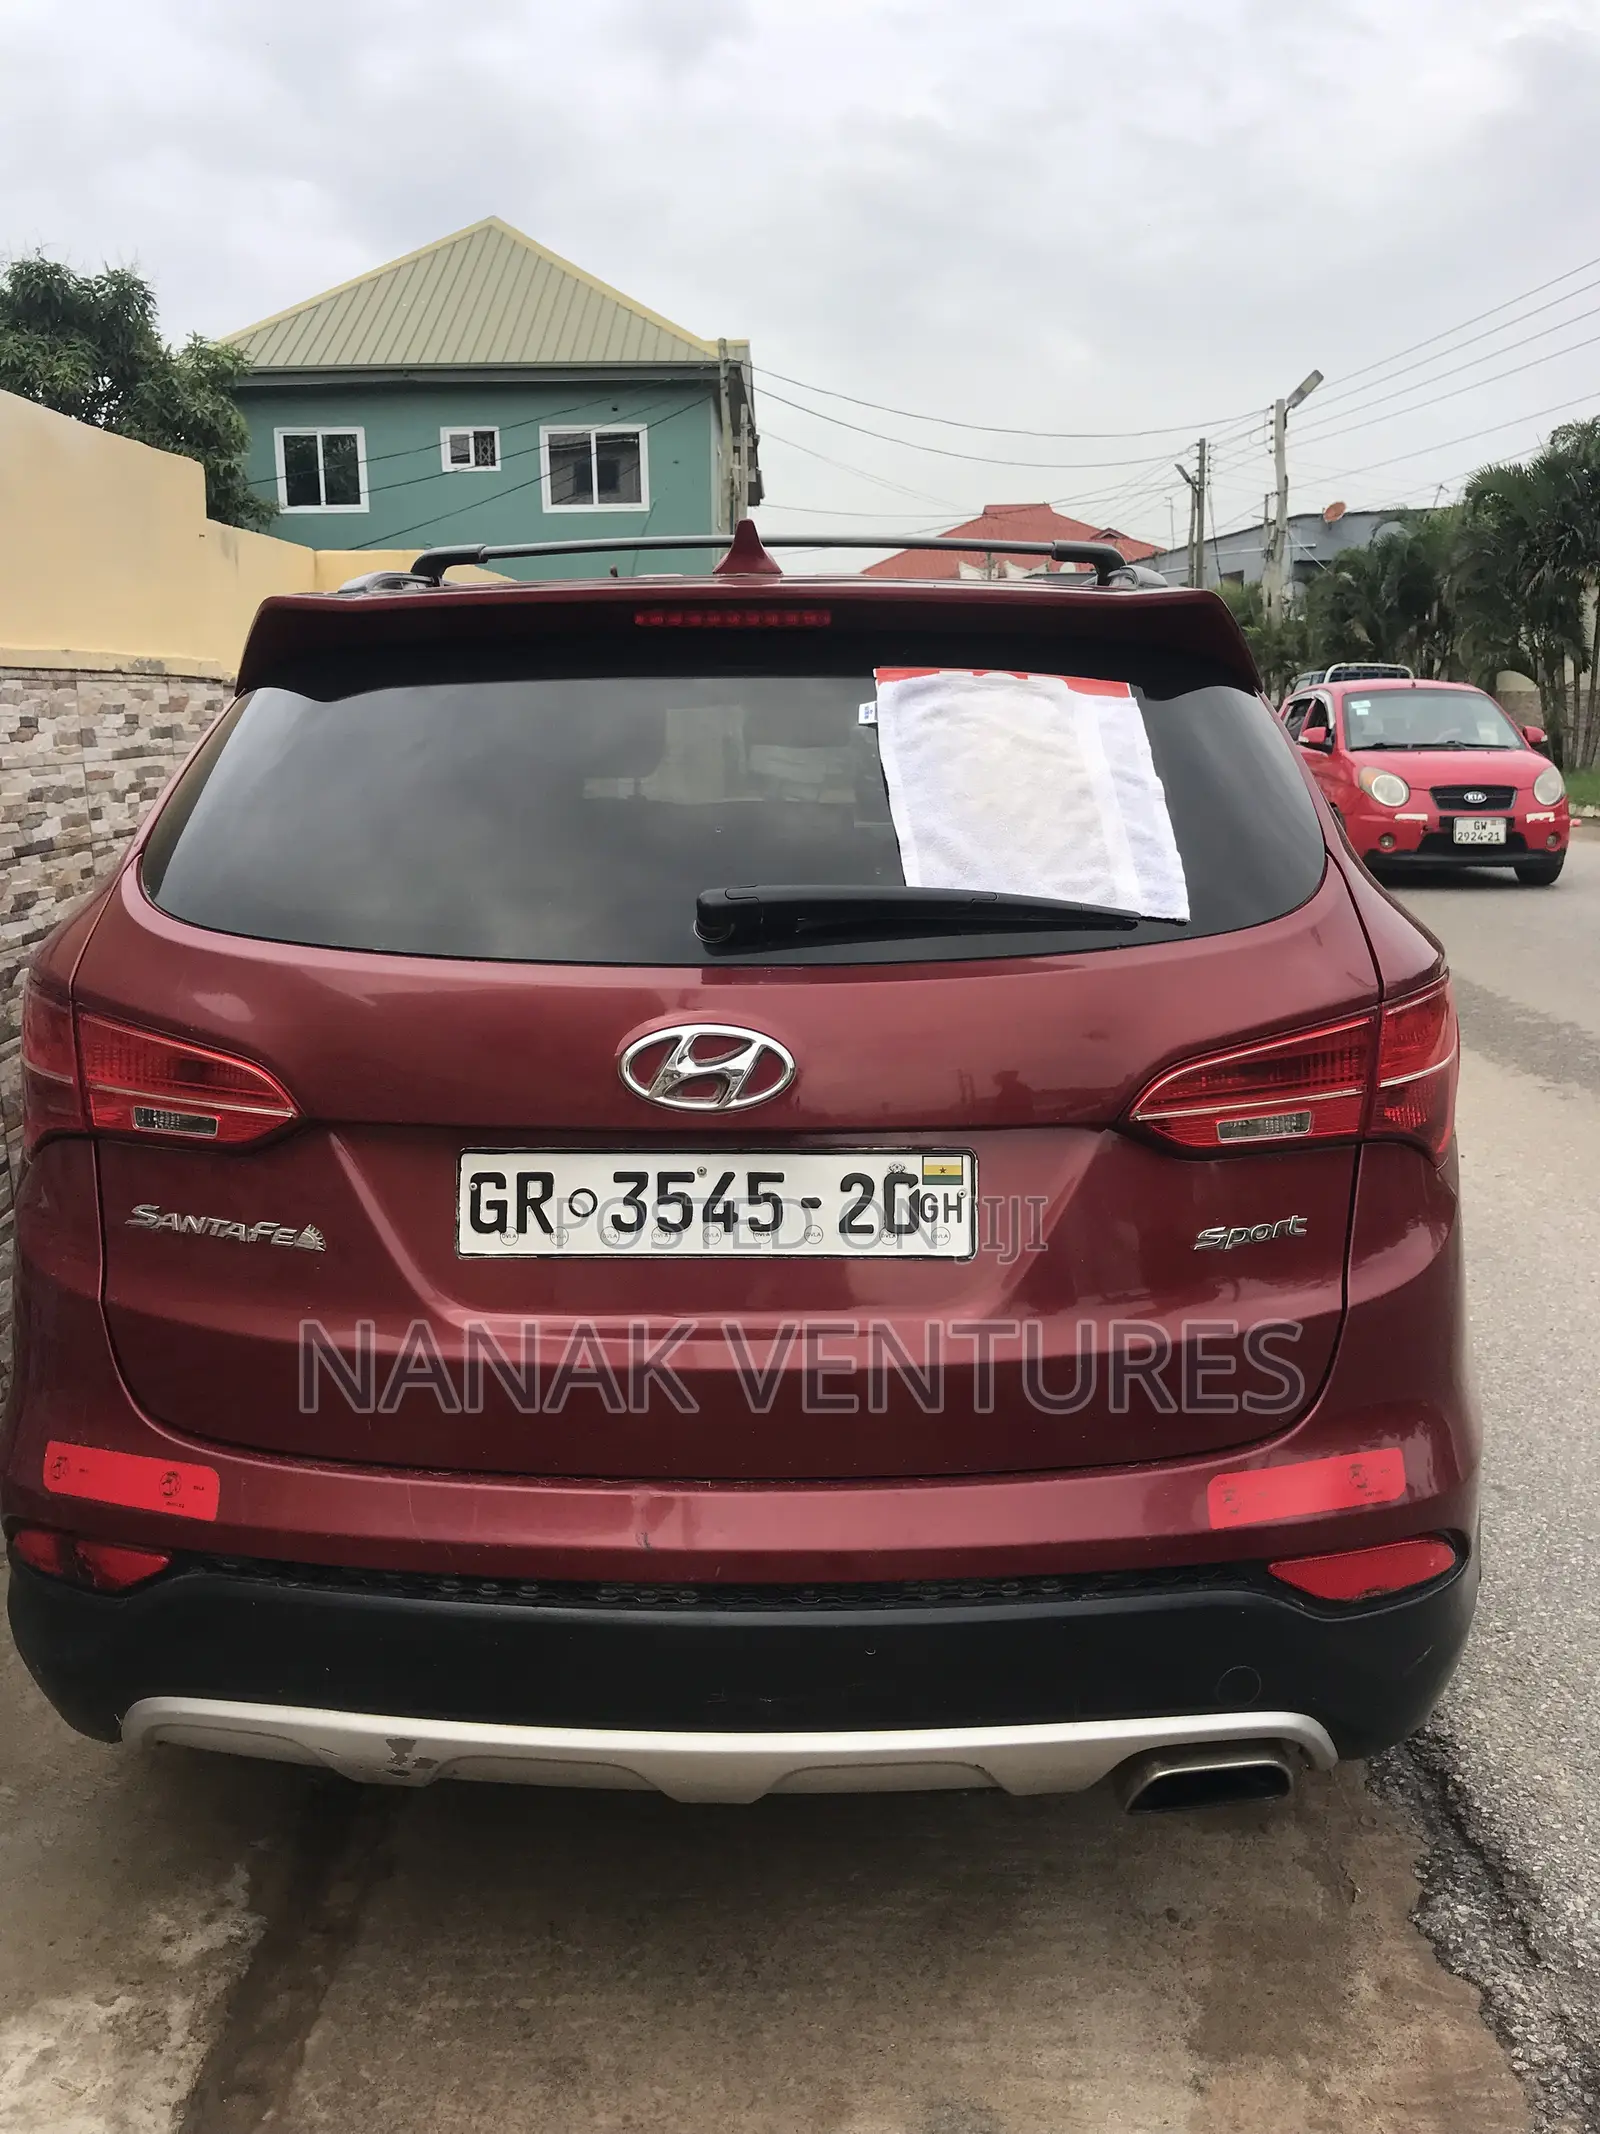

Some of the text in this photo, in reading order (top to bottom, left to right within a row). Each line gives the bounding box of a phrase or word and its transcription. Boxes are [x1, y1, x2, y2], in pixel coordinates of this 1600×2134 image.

[1467, 793, 1483, 801] KIA
[1473, 821, 1488, 830] GW
[1457, 832, 1501, 841] 2924-21
[469, 1171, 554, 1234] GR
[920, 1193, 963, 1223] GH
[1193, 1214, 1308, 1251] Sport
